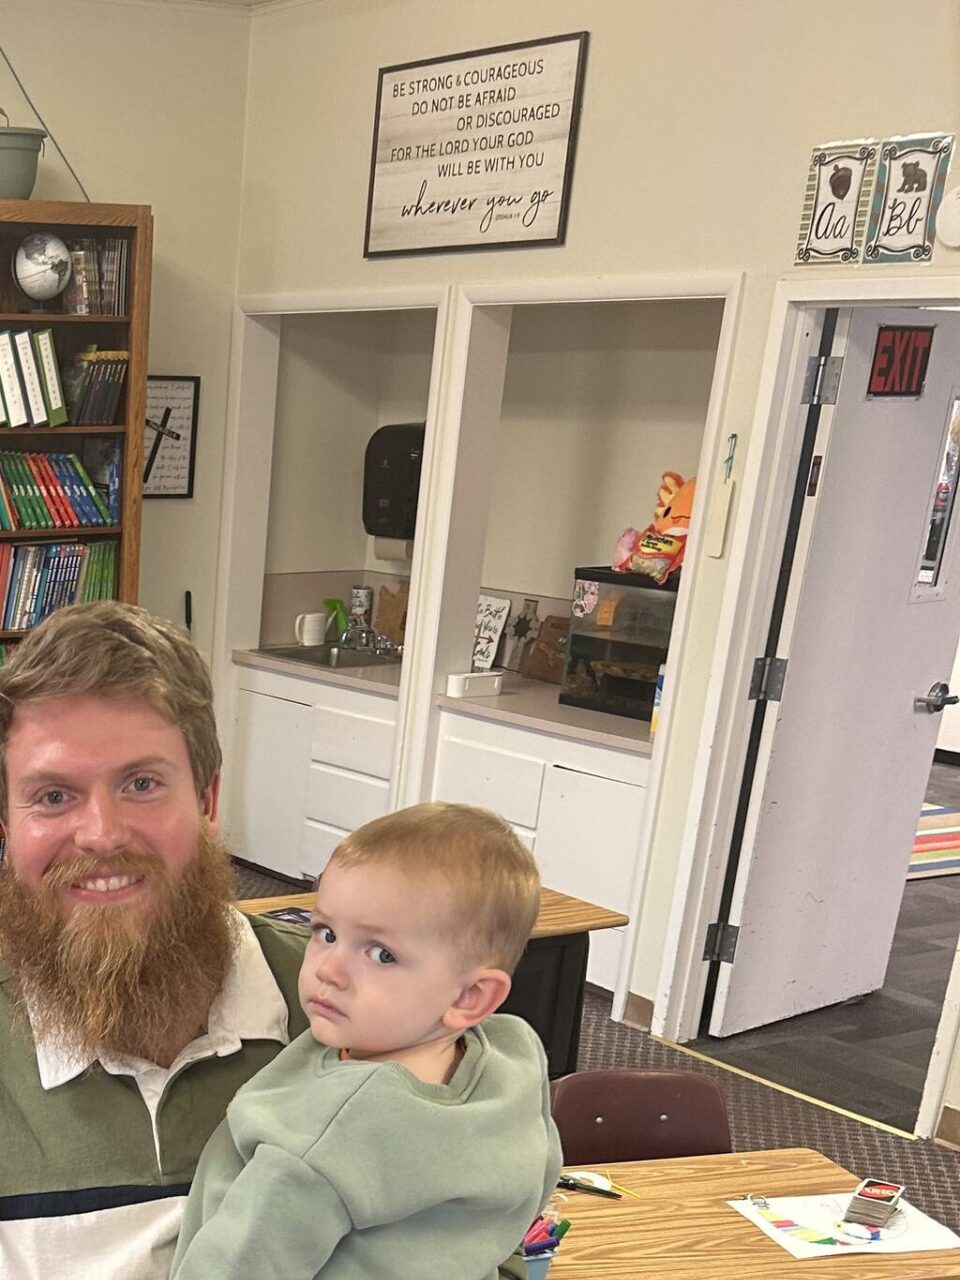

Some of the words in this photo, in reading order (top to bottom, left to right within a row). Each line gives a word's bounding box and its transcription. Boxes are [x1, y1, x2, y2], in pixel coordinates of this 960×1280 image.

[393, 83, 406, 98] BE
[409, 75, 453, 95] STRONG
[456, 74, 462, 87] &
[464, 59, 544, 86] COURAGEOUS
[412, 101, 428, 116] DO
[431, 97, 454, 113] NOT
[458, 94, 472, 109] BE
[474, 87, 516, 106] AFRAID
[456, 116, 473, 131] OR
[476, 103, 560, 129] DISCOURAGED
[391, 147, 412, 163] FOR
[415, 143, 436, 159] THE
[439, 139, 469, 156] LORD
[472, 134, 504, 151] YOUR
[507, 131, 534, 148] GOD
[437, 161, 463, 178] WILL
[467, 159, 481, 174] BE
[484, 156, 515, 172] WITH
[519, 152, 545, 168] YOU
[401, 180, 478, 218] wherever
[479, 194, 523, 233] you
[522, 189, 554, 227] go
[815, 202, 850, 240] Aa
[882, 197, 924, 236] Bb
[870, 331, 930, 392] EXIT
